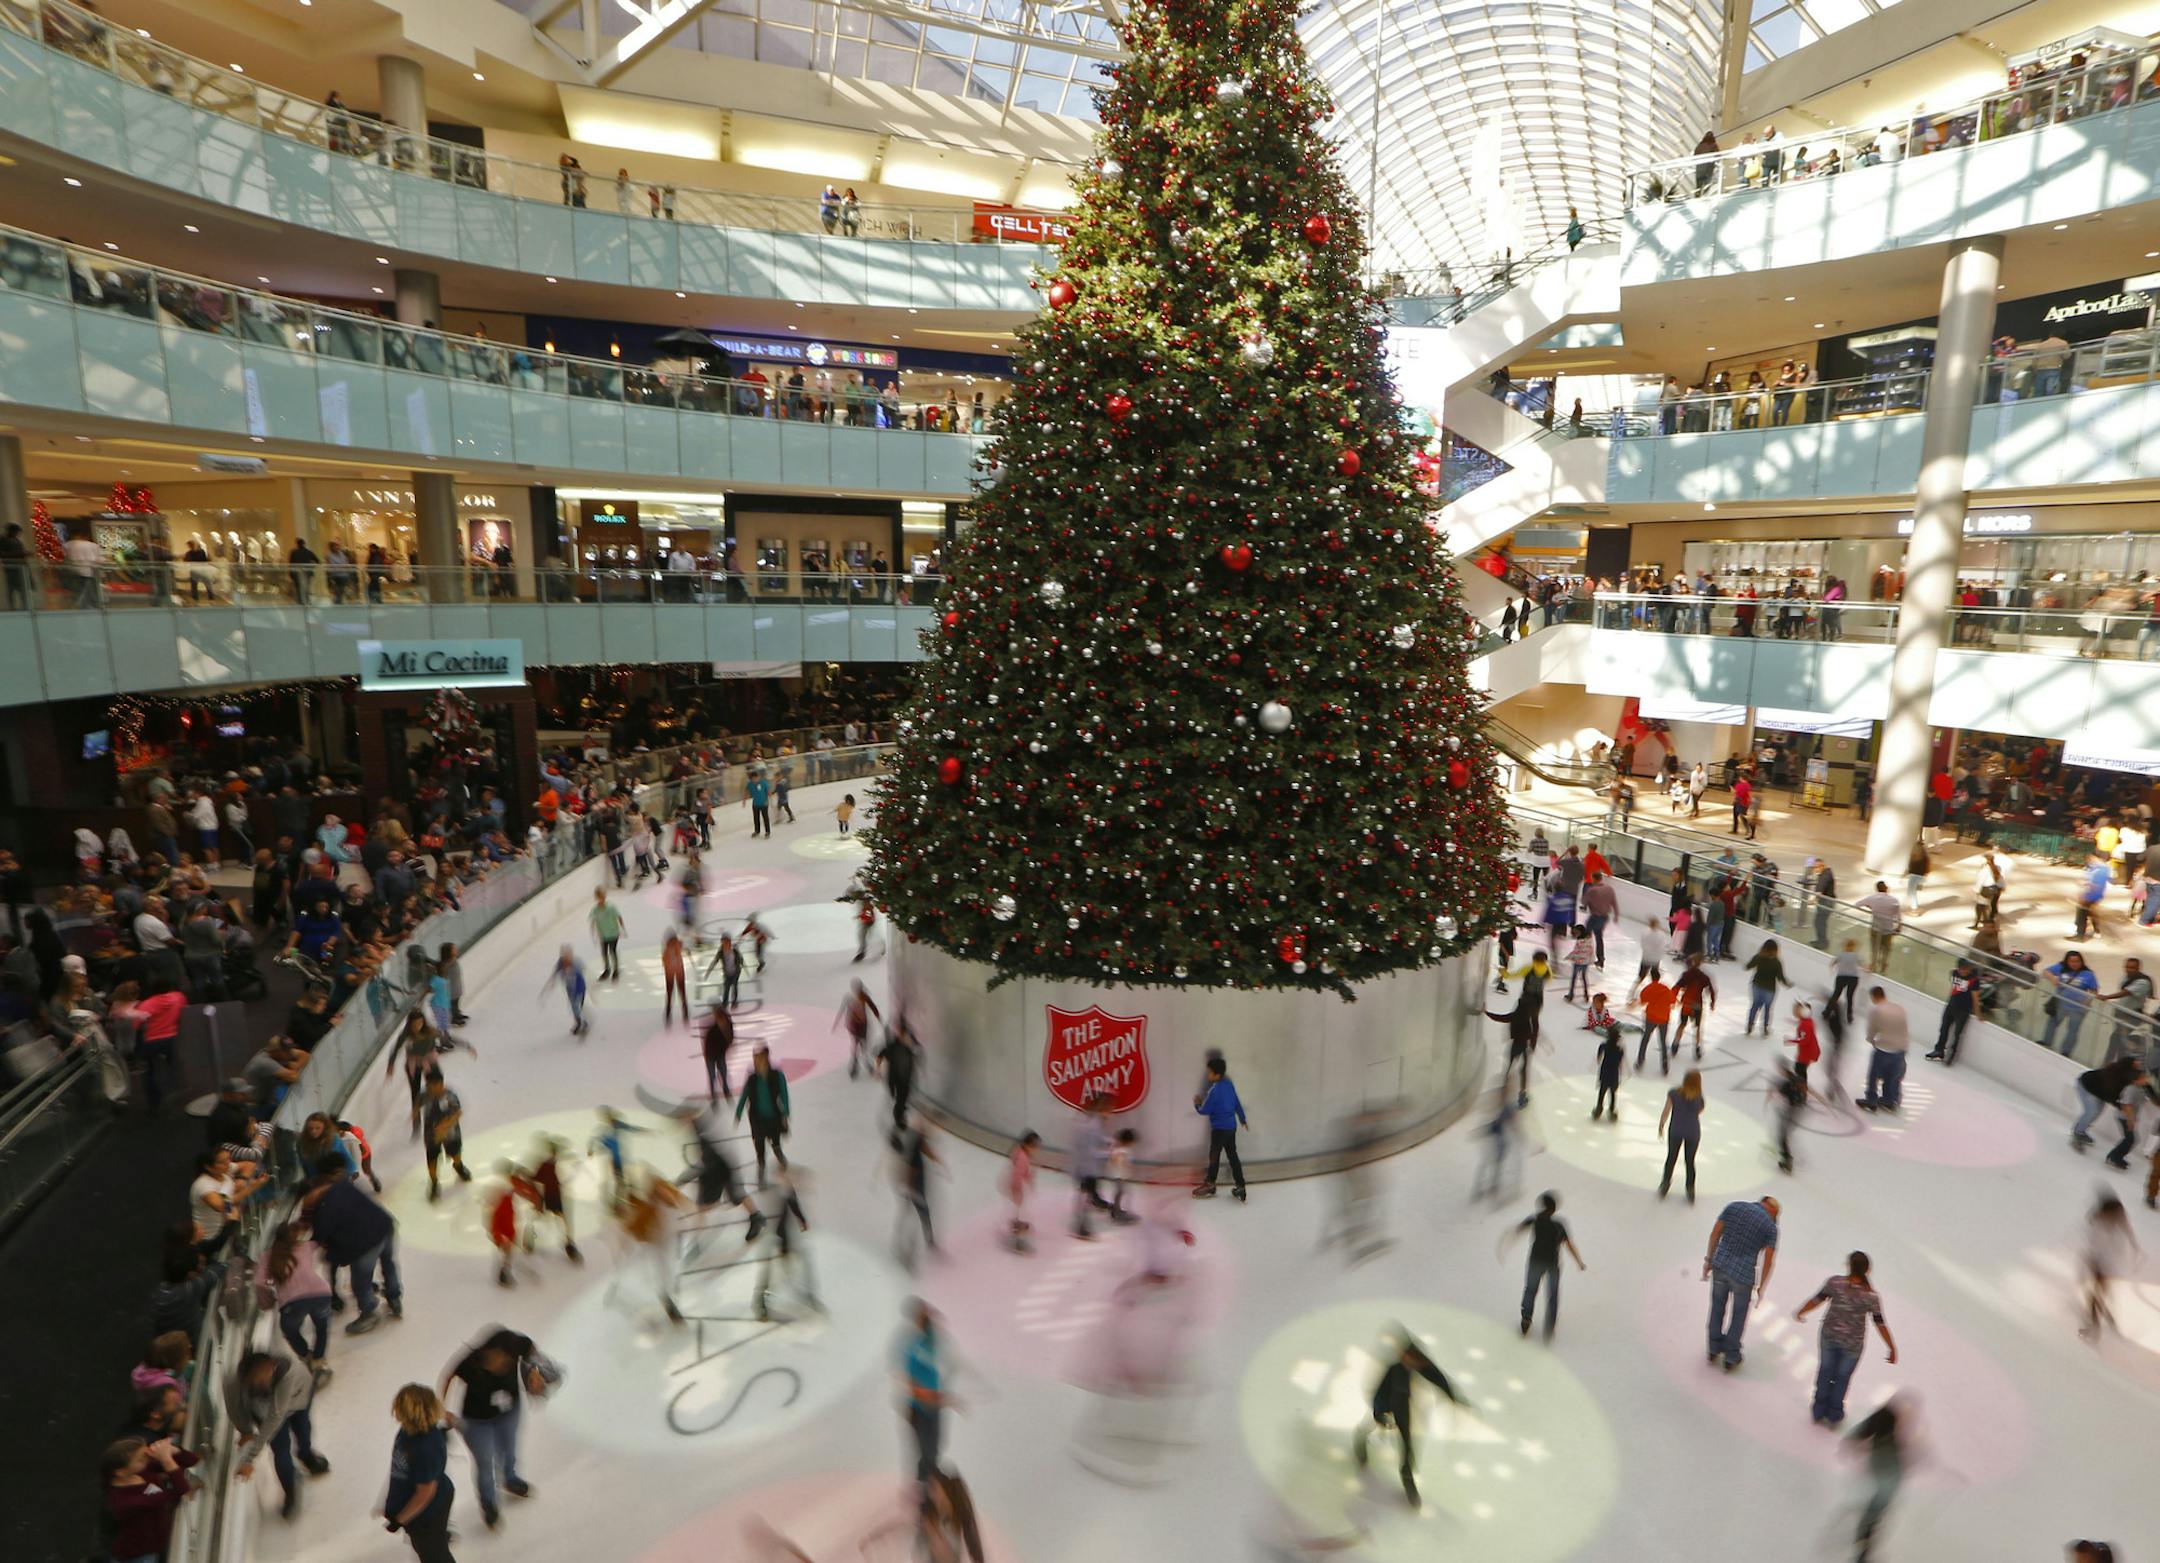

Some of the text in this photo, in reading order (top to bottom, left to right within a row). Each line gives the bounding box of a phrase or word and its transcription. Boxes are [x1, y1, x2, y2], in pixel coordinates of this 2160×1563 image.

[377, 650, 509, 674] Mi Cocina
[1062, 1018, 1102, 1050] THE
[1049, 1026, 1138, 1087] SALVATION
[1079, 1058, 1136, 1105] ARMY
